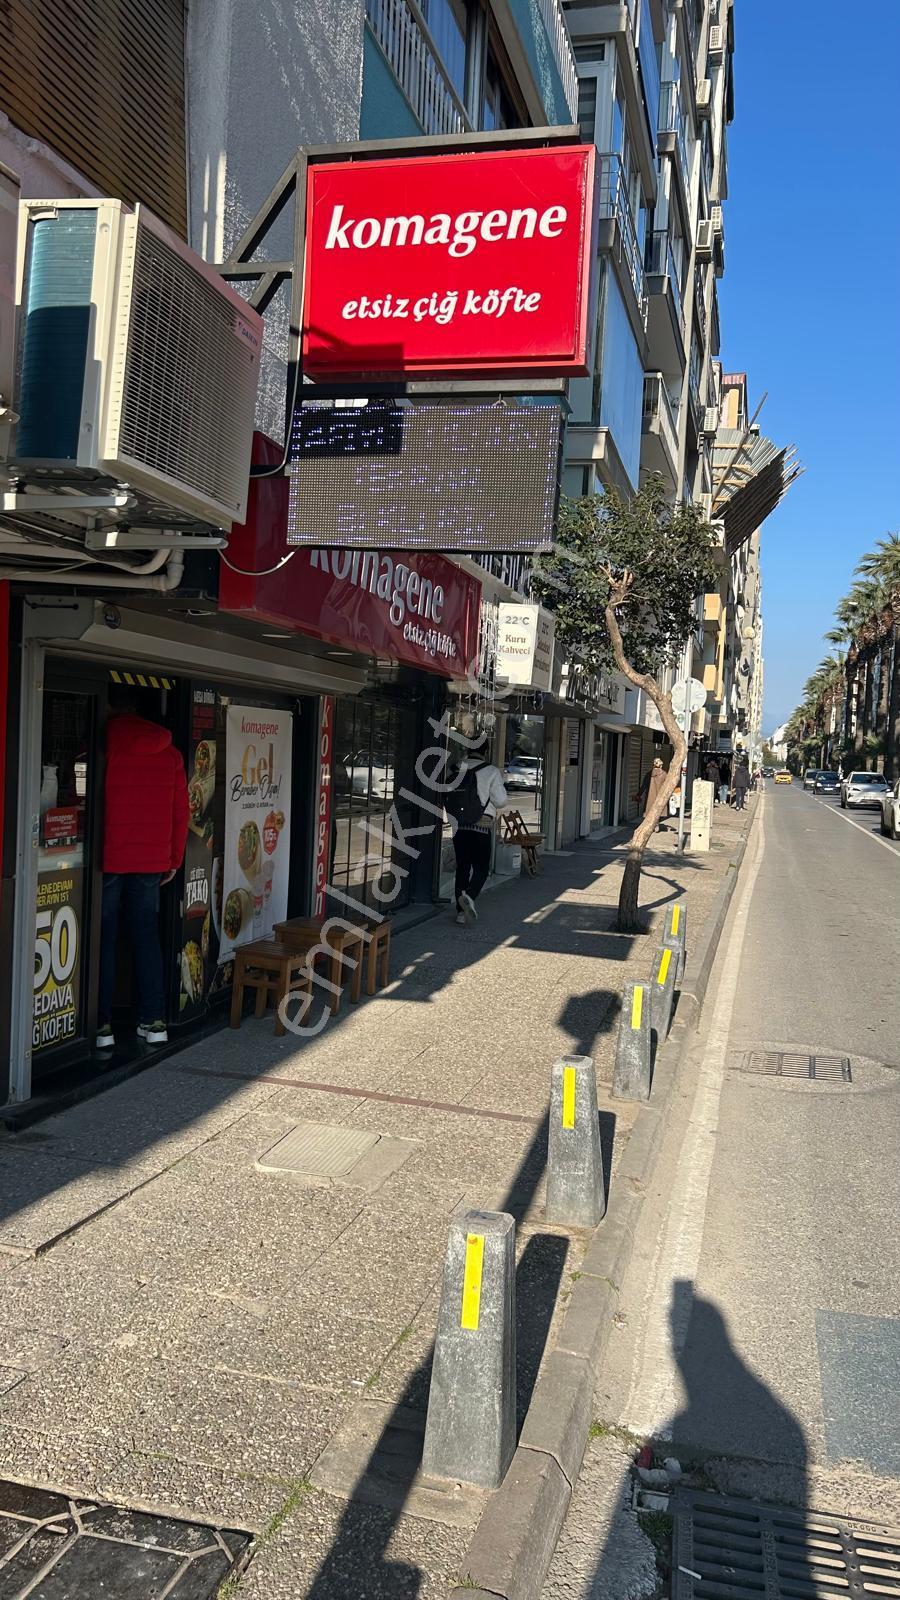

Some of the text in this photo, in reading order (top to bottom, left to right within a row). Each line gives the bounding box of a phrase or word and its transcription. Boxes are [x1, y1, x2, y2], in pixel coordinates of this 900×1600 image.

[324, 204, 568, 258] komagene
[342, 286, 542, 325] etsiz çiğ köfte
[403, 621, 425, 646] etsiz
[437, 630, 457, 659] köfte
[499, 644, 531, 655] Kahveci
[505, 633, 526, 643] Kuru
[241, 716, 279, 740] komagene
[242, 743, 274, 785] Gel
[315, 695, 332, 915] komagen
[186, 879, 209, 909] TAKO
[33, 988, 73, 1016] EDAVA
[42, 1009, 75, 1043] KÖFTE
